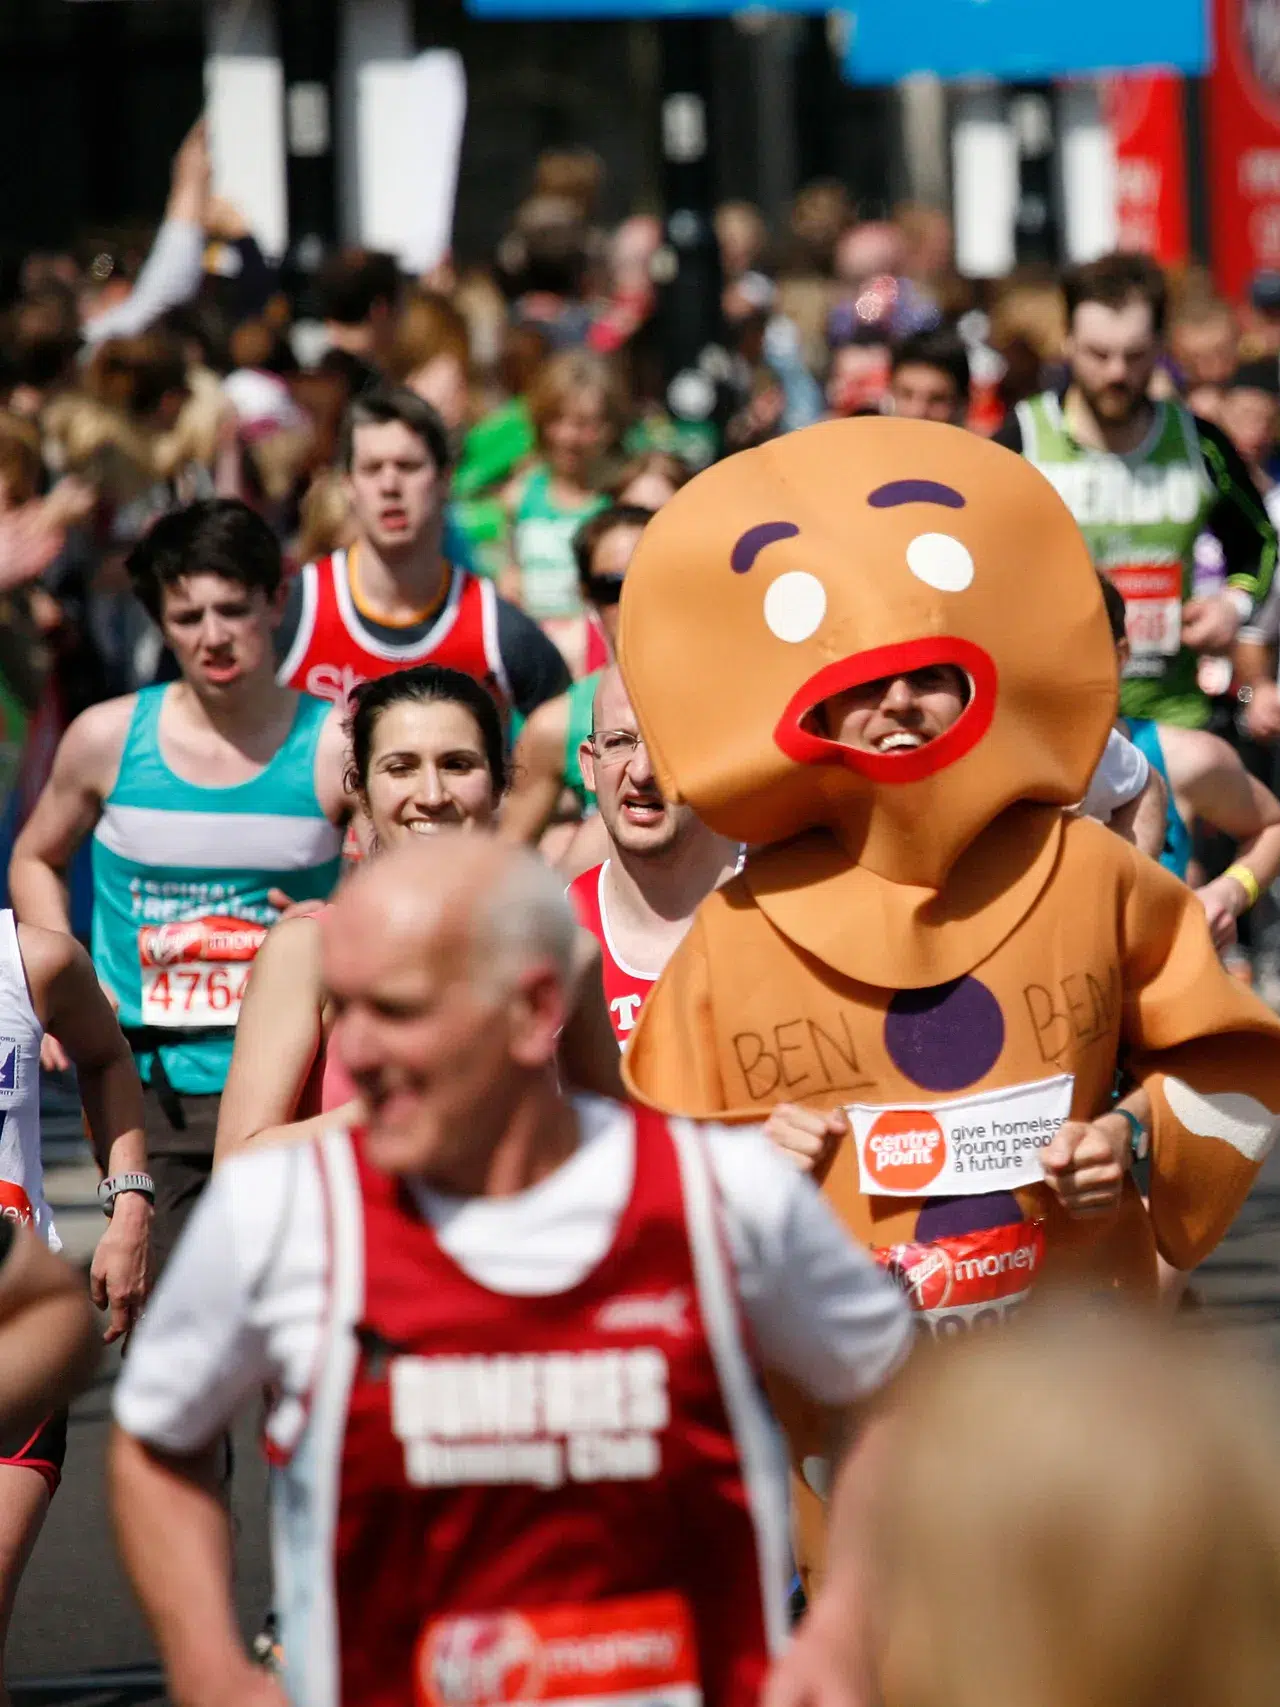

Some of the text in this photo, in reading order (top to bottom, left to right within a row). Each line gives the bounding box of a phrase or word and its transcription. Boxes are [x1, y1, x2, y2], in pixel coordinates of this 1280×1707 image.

[732, 1010, 861, 1101] BEN
[869, 1130, 939, 1152] centre
[951, 1126, 986, 1145] give
[876, 1147, 933, 1171] point
[952, 1139, 1006, 1160] young
[955, 1155, 1022, 1173] a future
[954, 1244, 1037, 1282] money
